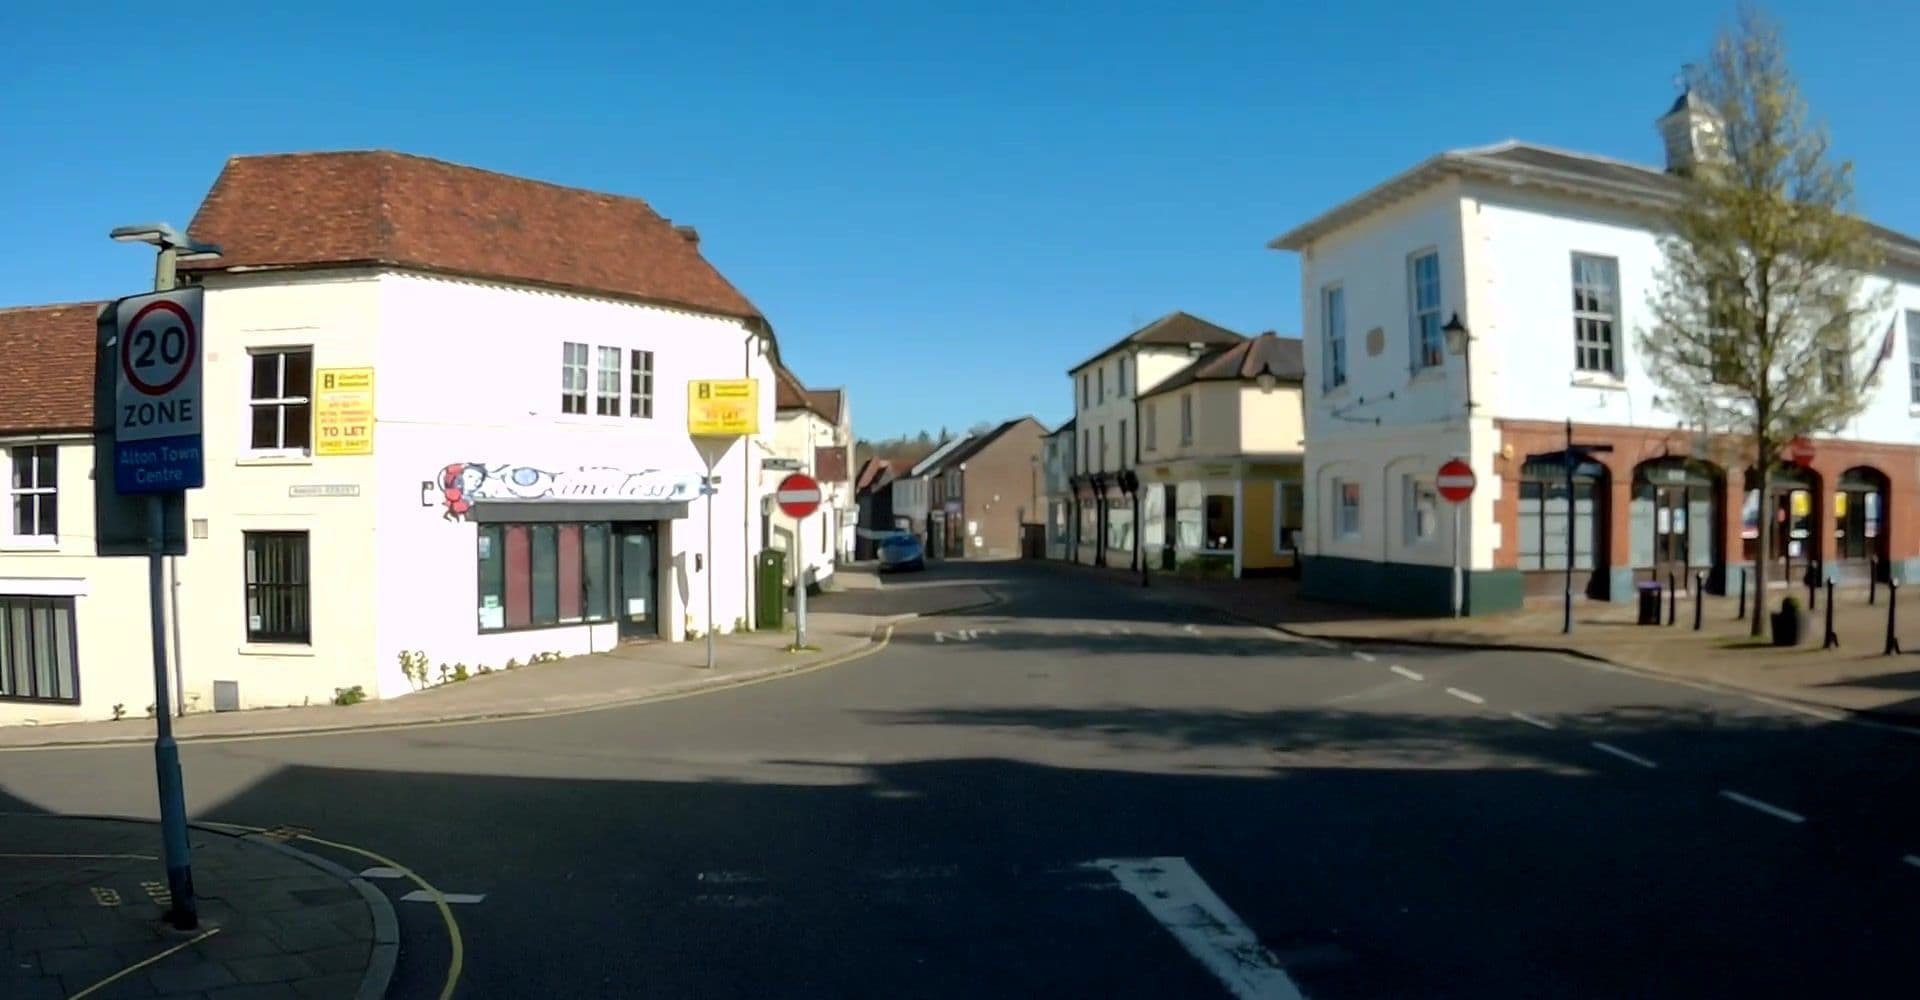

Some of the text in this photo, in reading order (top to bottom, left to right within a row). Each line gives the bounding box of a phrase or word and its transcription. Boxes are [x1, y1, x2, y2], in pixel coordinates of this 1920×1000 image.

[134, 326, 185, 368] 20
[124, 399, 193, 428] ZONE
[322, 426, 367, 437] TO LET
[120, 446, 199, 465] Alton Town
[136, 467, 183, 484] Centre
